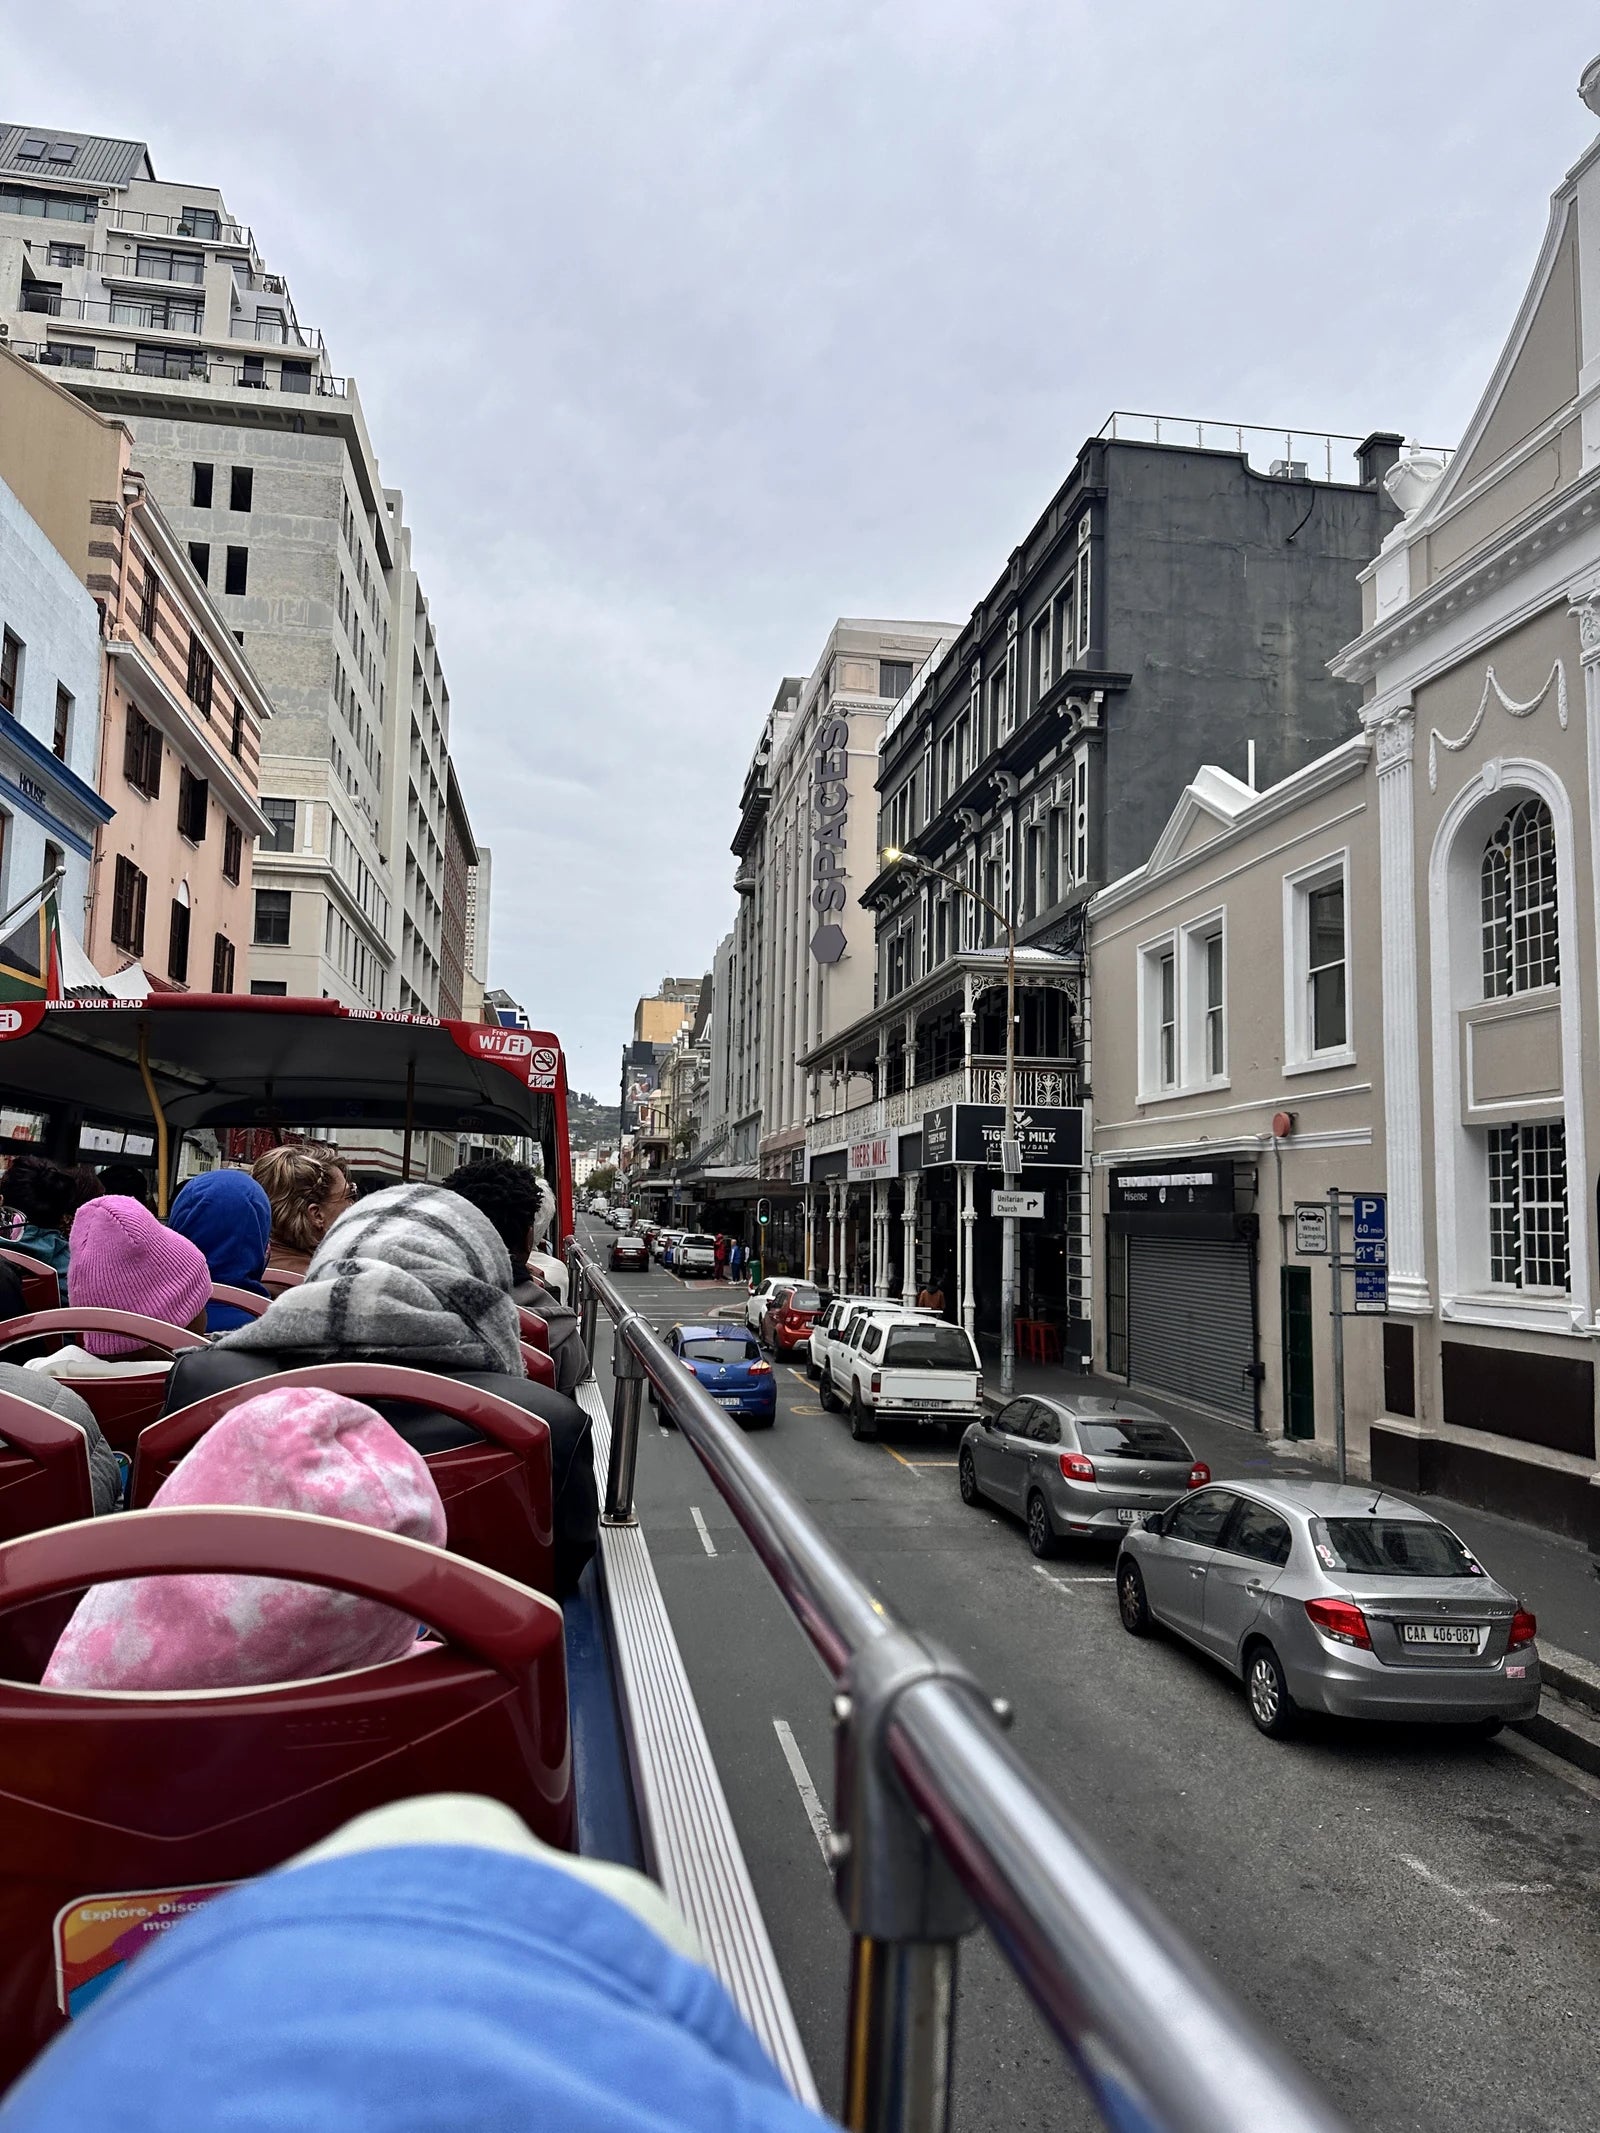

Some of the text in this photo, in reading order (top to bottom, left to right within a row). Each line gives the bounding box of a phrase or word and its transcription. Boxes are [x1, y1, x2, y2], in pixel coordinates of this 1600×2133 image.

[19, 772, 47, 808] HOUSE
[812, 719, 849, 912] SPACES
[45, 1000, 143, 1010] MIND YOUR HEAD
[348, 1009, 441, 1027] MIND YOUR HEAD
[981, 1129, 1057, 1143] TIGE'S MILK
[997, 1195, 1024, 1203] Unitarian
[1124, 1190, 1148, 1201] Hisense
[997, 1204, 1018, 1213] Church
[1361, 1200, 1378, 1220] P
[1302, 1224, 1321, 1232] Wheel
[1357, 1223, 1369, 1234] 60
[1298, 1232, 1326, 1241] Clamping
[1304, 1240, 1320, 1248] Zone
[1119, 1509, 1134, 1520] CAA
[1406, 1627, 1475, 1643] CAA 406-087
